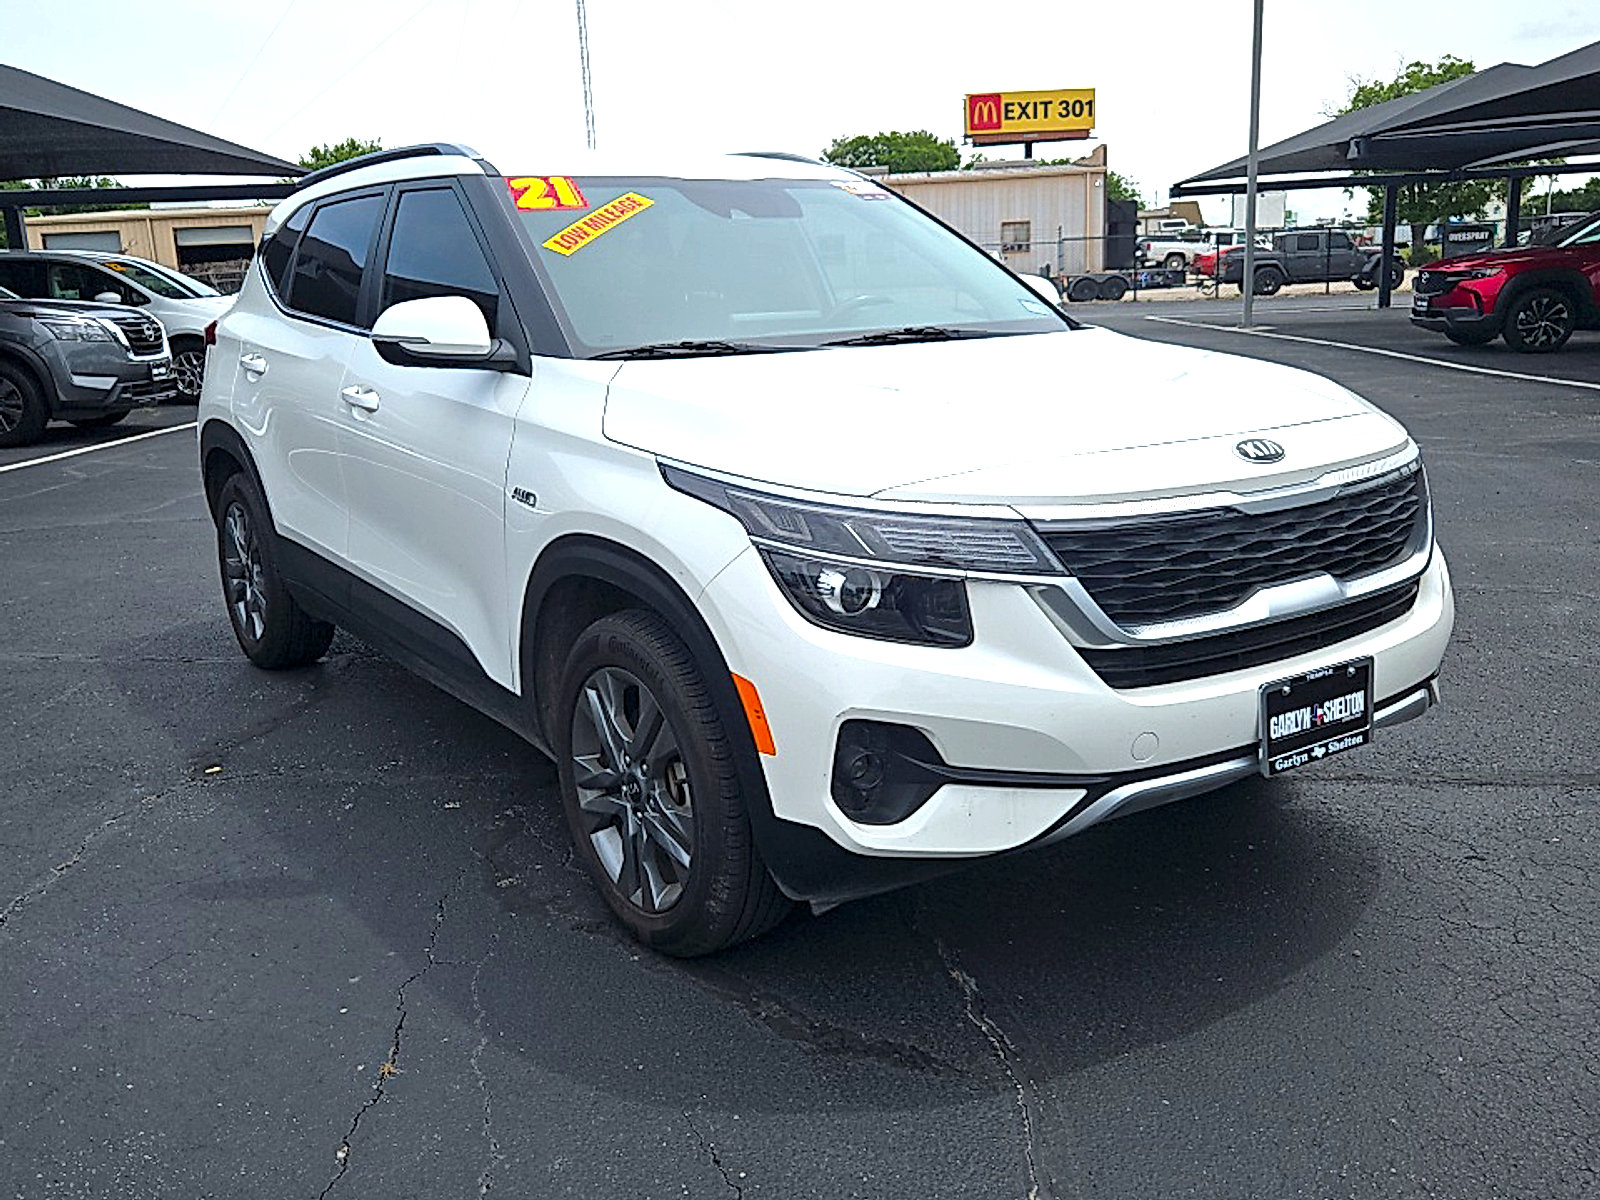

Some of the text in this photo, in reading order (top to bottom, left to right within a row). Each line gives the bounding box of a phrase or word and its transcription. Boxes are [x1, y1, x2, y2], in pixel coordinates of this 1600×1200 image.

[1004, 100, 1053, 121] EXIT
[1057, 99, 1093, 118] 301
[509, 176, 581, 209] 21
[553, 196, 644, 251] LOW MILEAGE
[1237, 440, 1284, 460] KIA
[1269, 689, 1365, 740] GARLYN SHELTON
[1275, 734, 1364, 771] Garlyn Shelton
